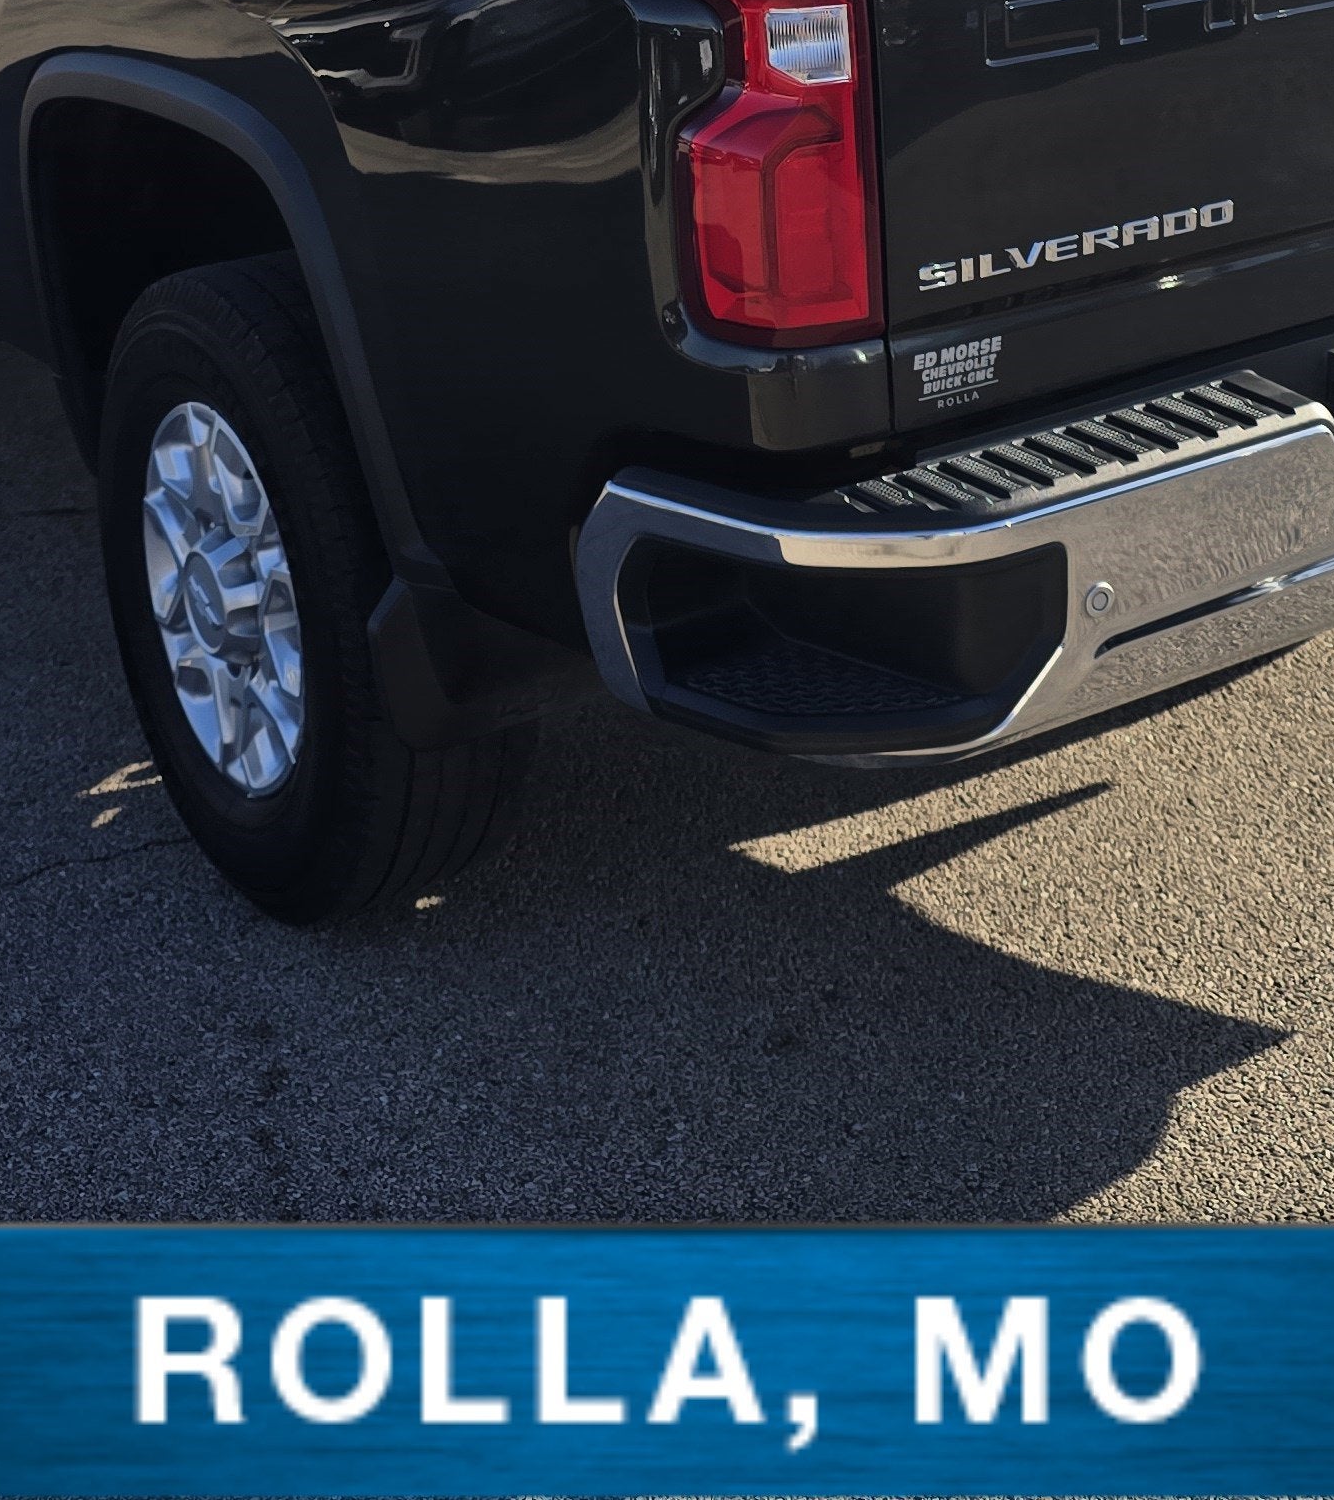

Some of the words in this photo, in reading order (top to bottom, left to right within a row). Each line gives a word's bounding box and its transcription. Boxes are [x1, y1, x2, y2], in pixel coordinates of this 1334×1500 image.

[918, 199, 1234, 292] SILVERADO
[913, 351, 938, 371] ED
[940, 335, 1003, 366] MORSE
[921, 352, 998, 383] CHEVROLET
[937, 390, 980, 409] ROLLA
